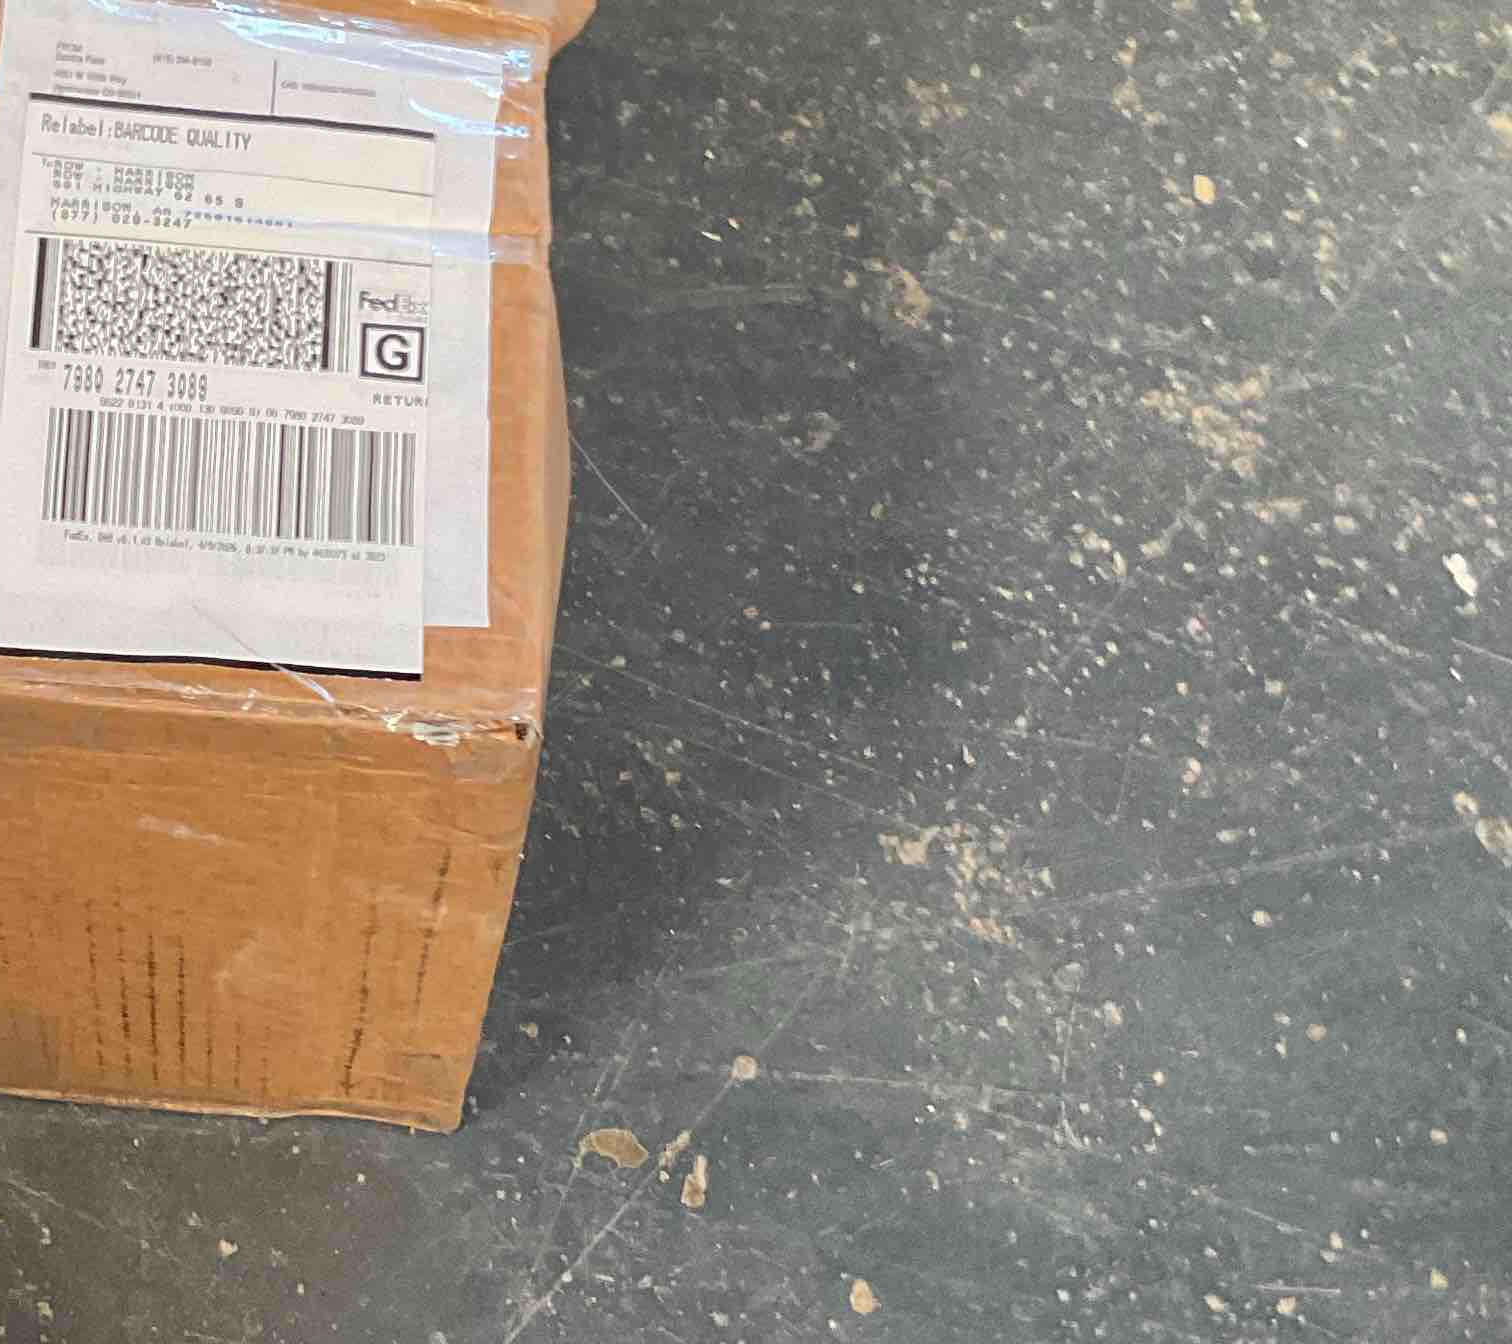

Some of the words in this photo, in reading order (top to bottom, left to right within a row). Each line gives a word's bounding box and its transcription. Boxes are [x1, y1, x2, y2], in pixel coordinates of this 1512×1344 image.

[187, 127, 252, 150] QUALITY
[376, 334, 409, 371] G
[63, 364, 104, 394] 7980
[114, 367, 156, 398] 2747
[167, 371, 208, 402] 3089
